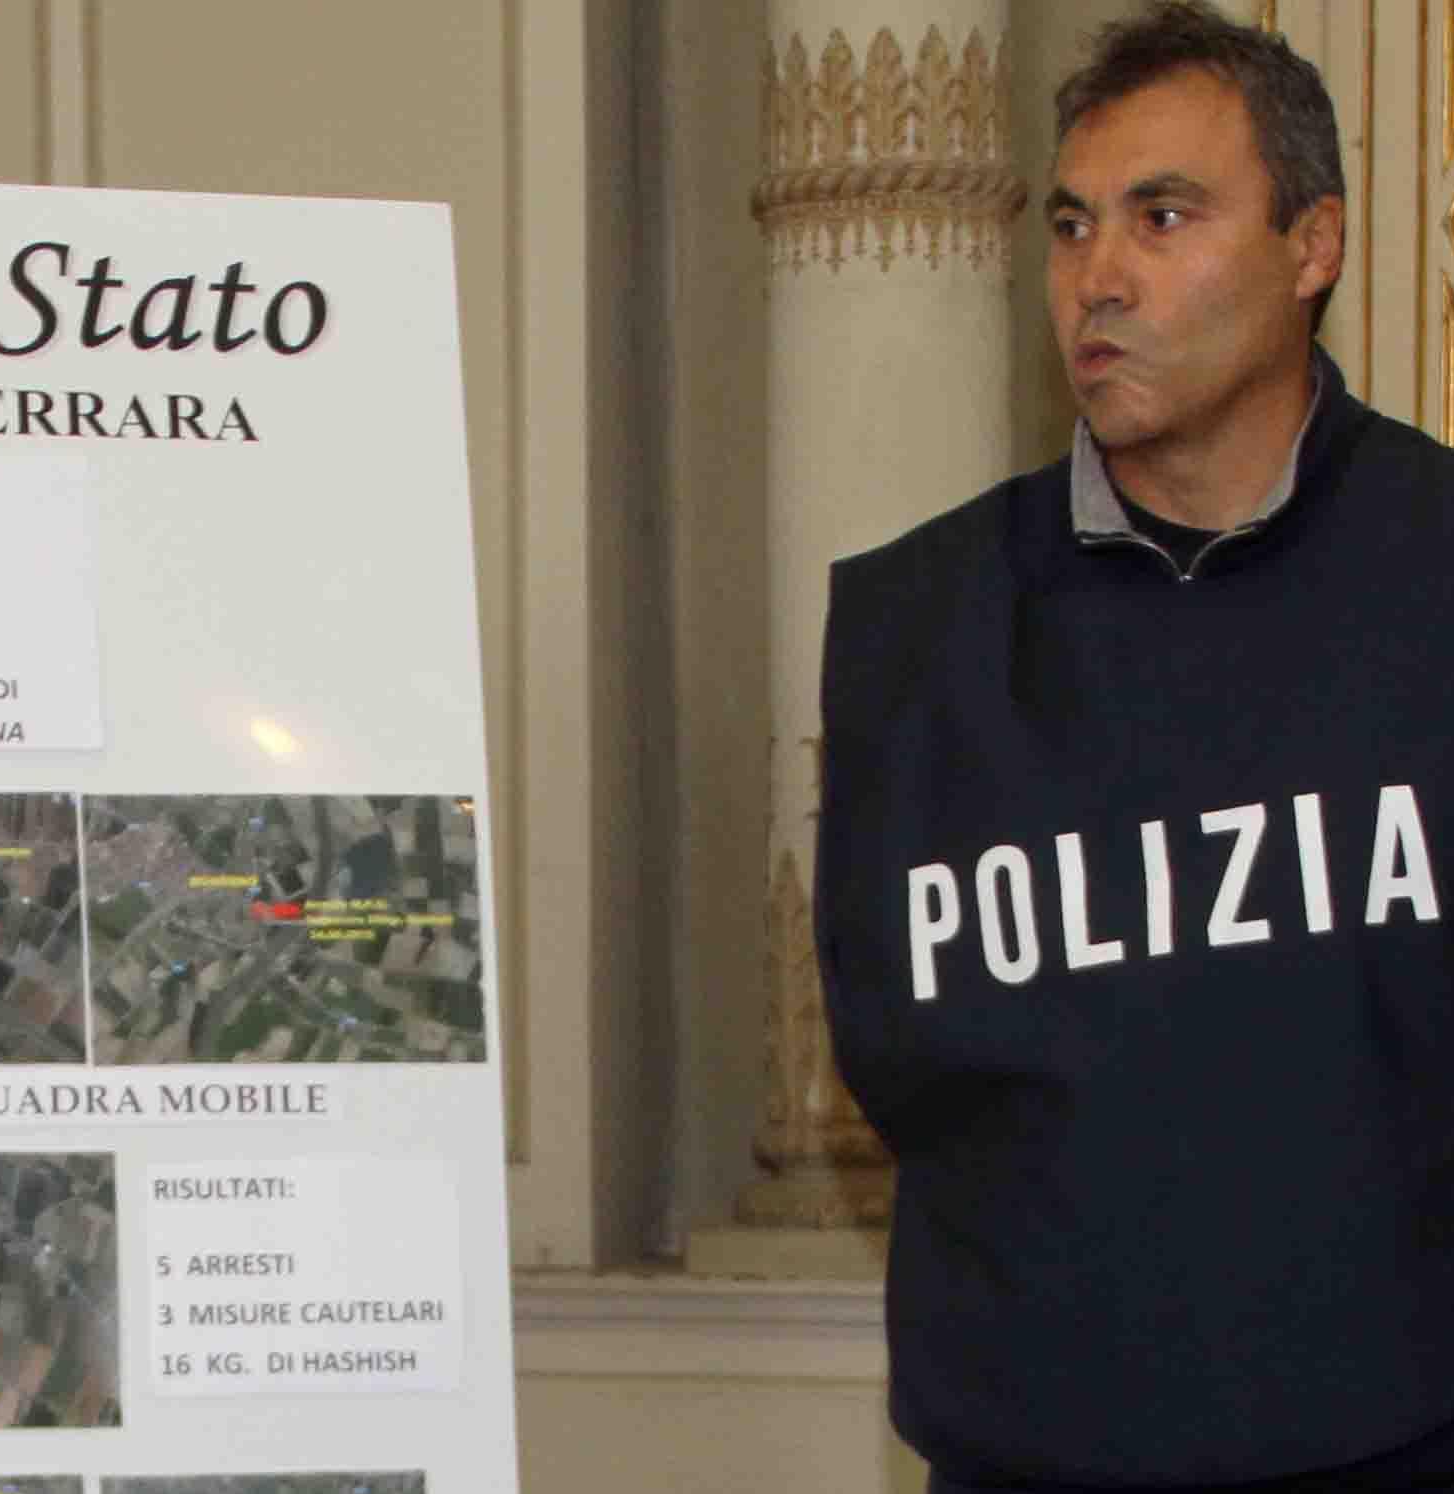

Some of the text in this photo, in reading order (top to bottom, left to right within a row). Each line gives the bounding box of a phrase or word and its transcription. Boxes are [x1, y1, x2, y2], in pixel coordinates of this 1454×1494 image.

[907, 784, 1441, 1002] POLIZIA
[159, 1083, 329, 1117] MOBILE
[153, 1176, 297, 1203] RISULTATI:
[157, 1253, 295, 1278] 5 ARRESTI
[159, 1300, 445, 1327] 3 MISURE CAUTELARI
[161, 1350, 418, 1376] 16 KG. DI HASHISH
